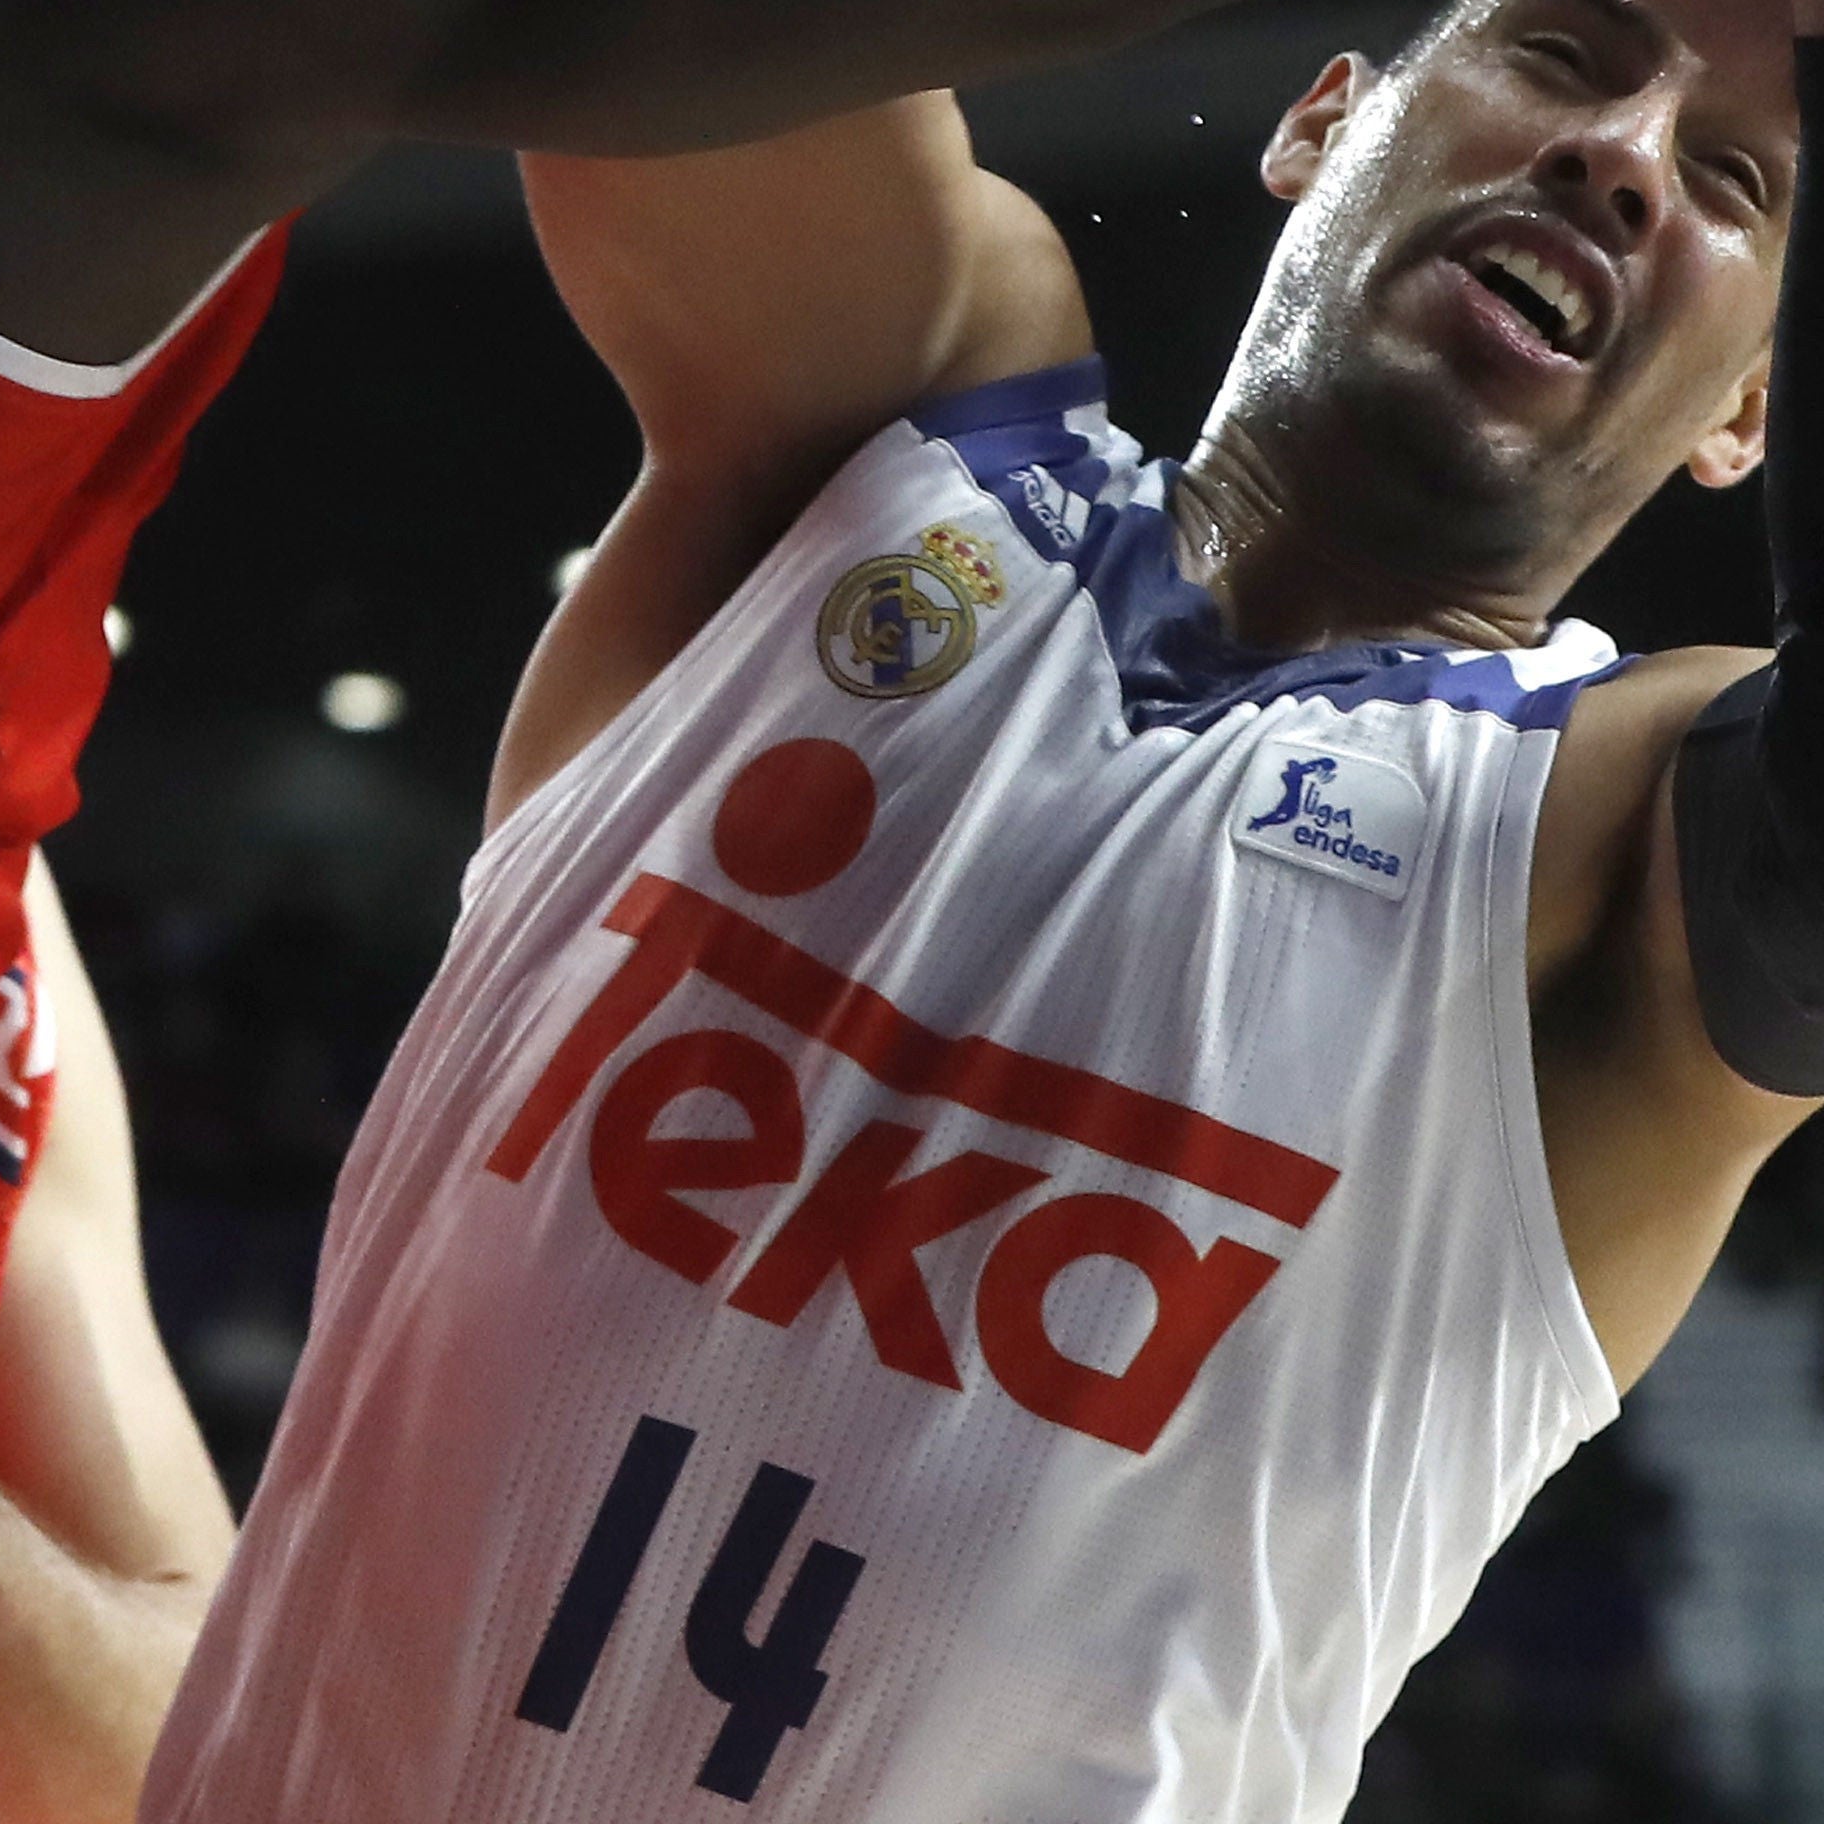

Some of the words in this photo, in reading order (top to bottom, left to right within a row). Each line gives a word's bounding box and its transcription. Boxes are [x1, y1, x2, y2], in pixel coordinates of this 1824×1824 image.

[1293, 825, 1401, 878] endesa
[1303, 780, 1353, 828] liga
[485, 871, 1341, 1456] Teka
[514, 1414, 867, 1804] 14
